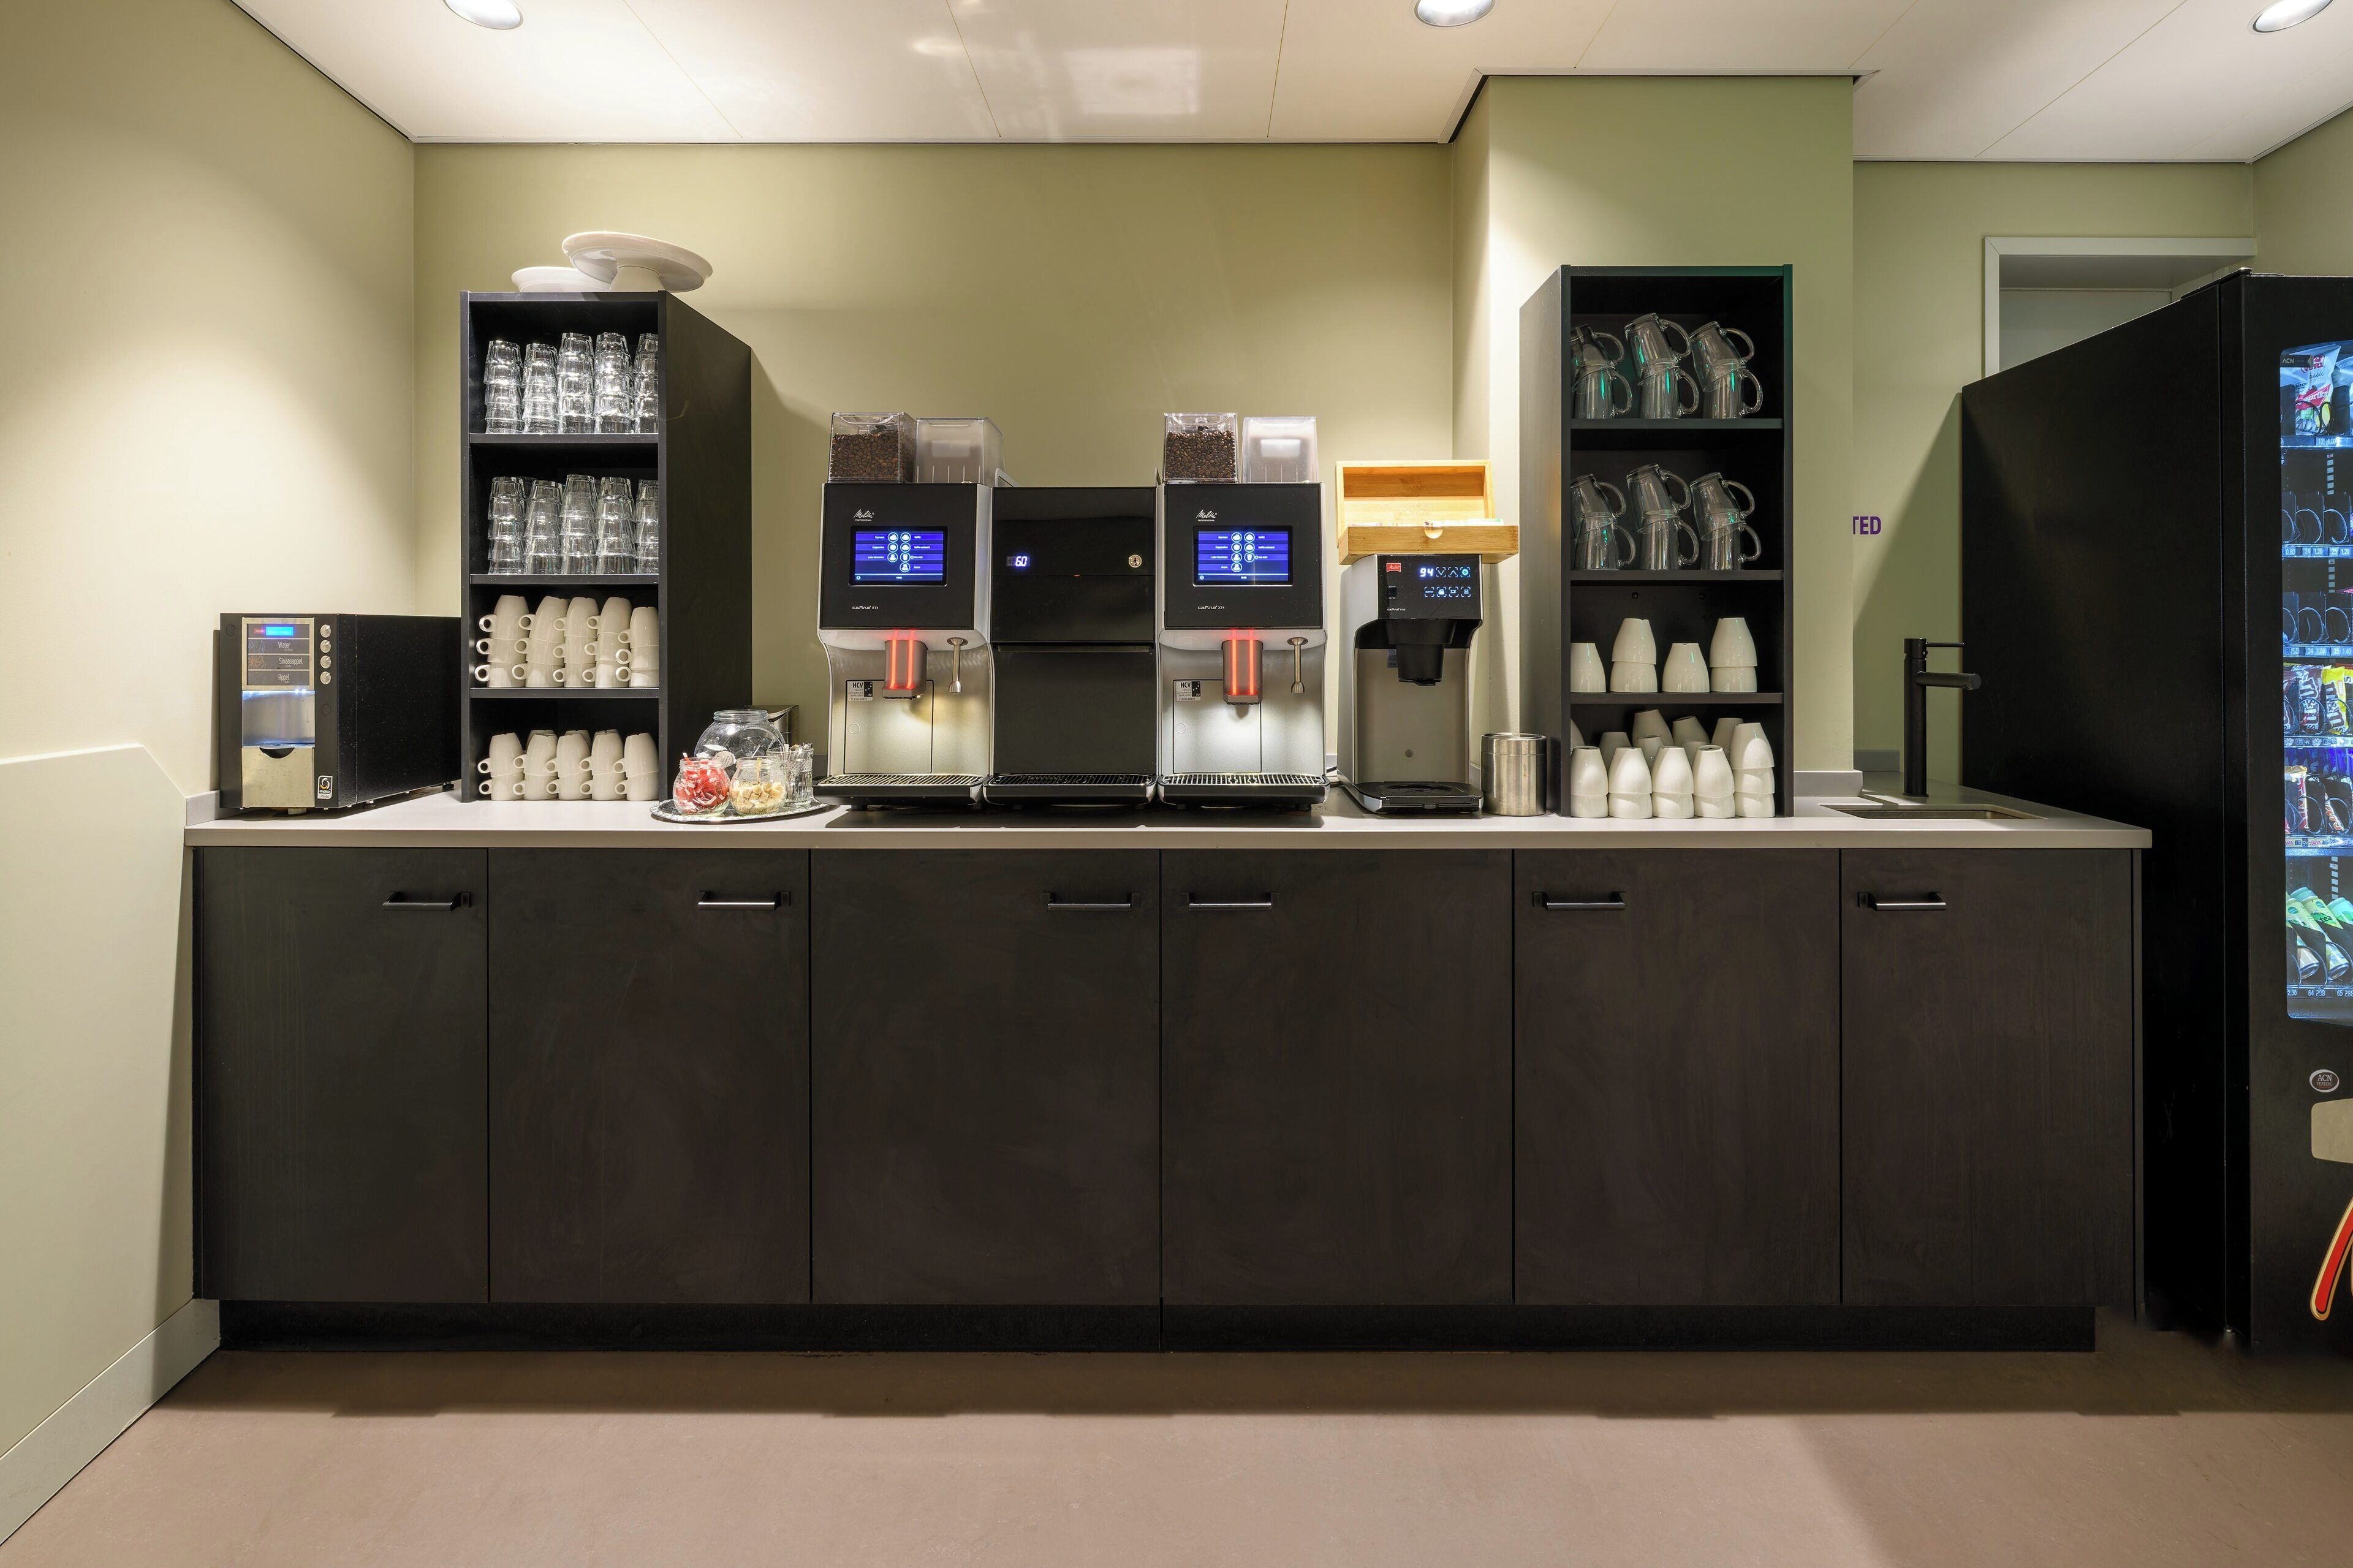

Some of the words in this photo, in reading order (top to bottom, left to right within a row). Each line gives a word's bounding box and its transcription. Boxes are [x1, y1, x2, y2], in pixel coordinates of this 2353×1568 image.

[1015, 556, 1028, 567] 60
[1420, 567, 1434, 577] 94
[278, 673, 290, 682] Appel
